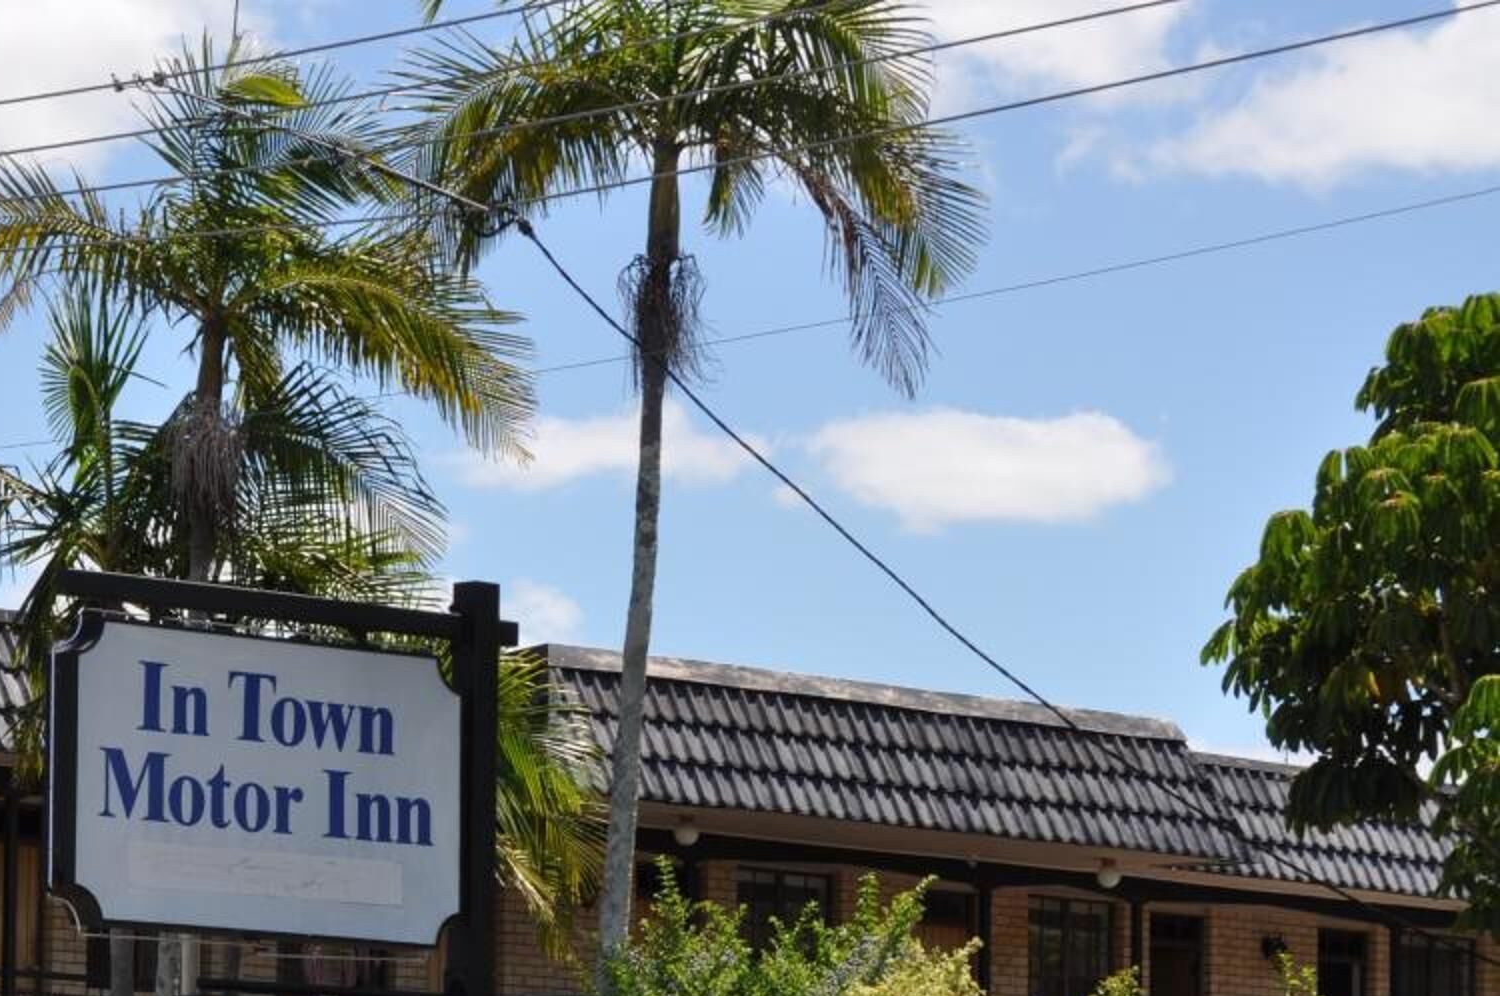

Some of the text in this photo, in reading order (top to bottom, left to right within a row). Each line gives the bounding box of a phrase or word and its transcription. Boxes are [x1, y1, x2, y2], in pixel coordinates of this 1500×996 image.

[136, 660, 395, 756] In Town
[99, 746, 434, 847] Motor Inn
